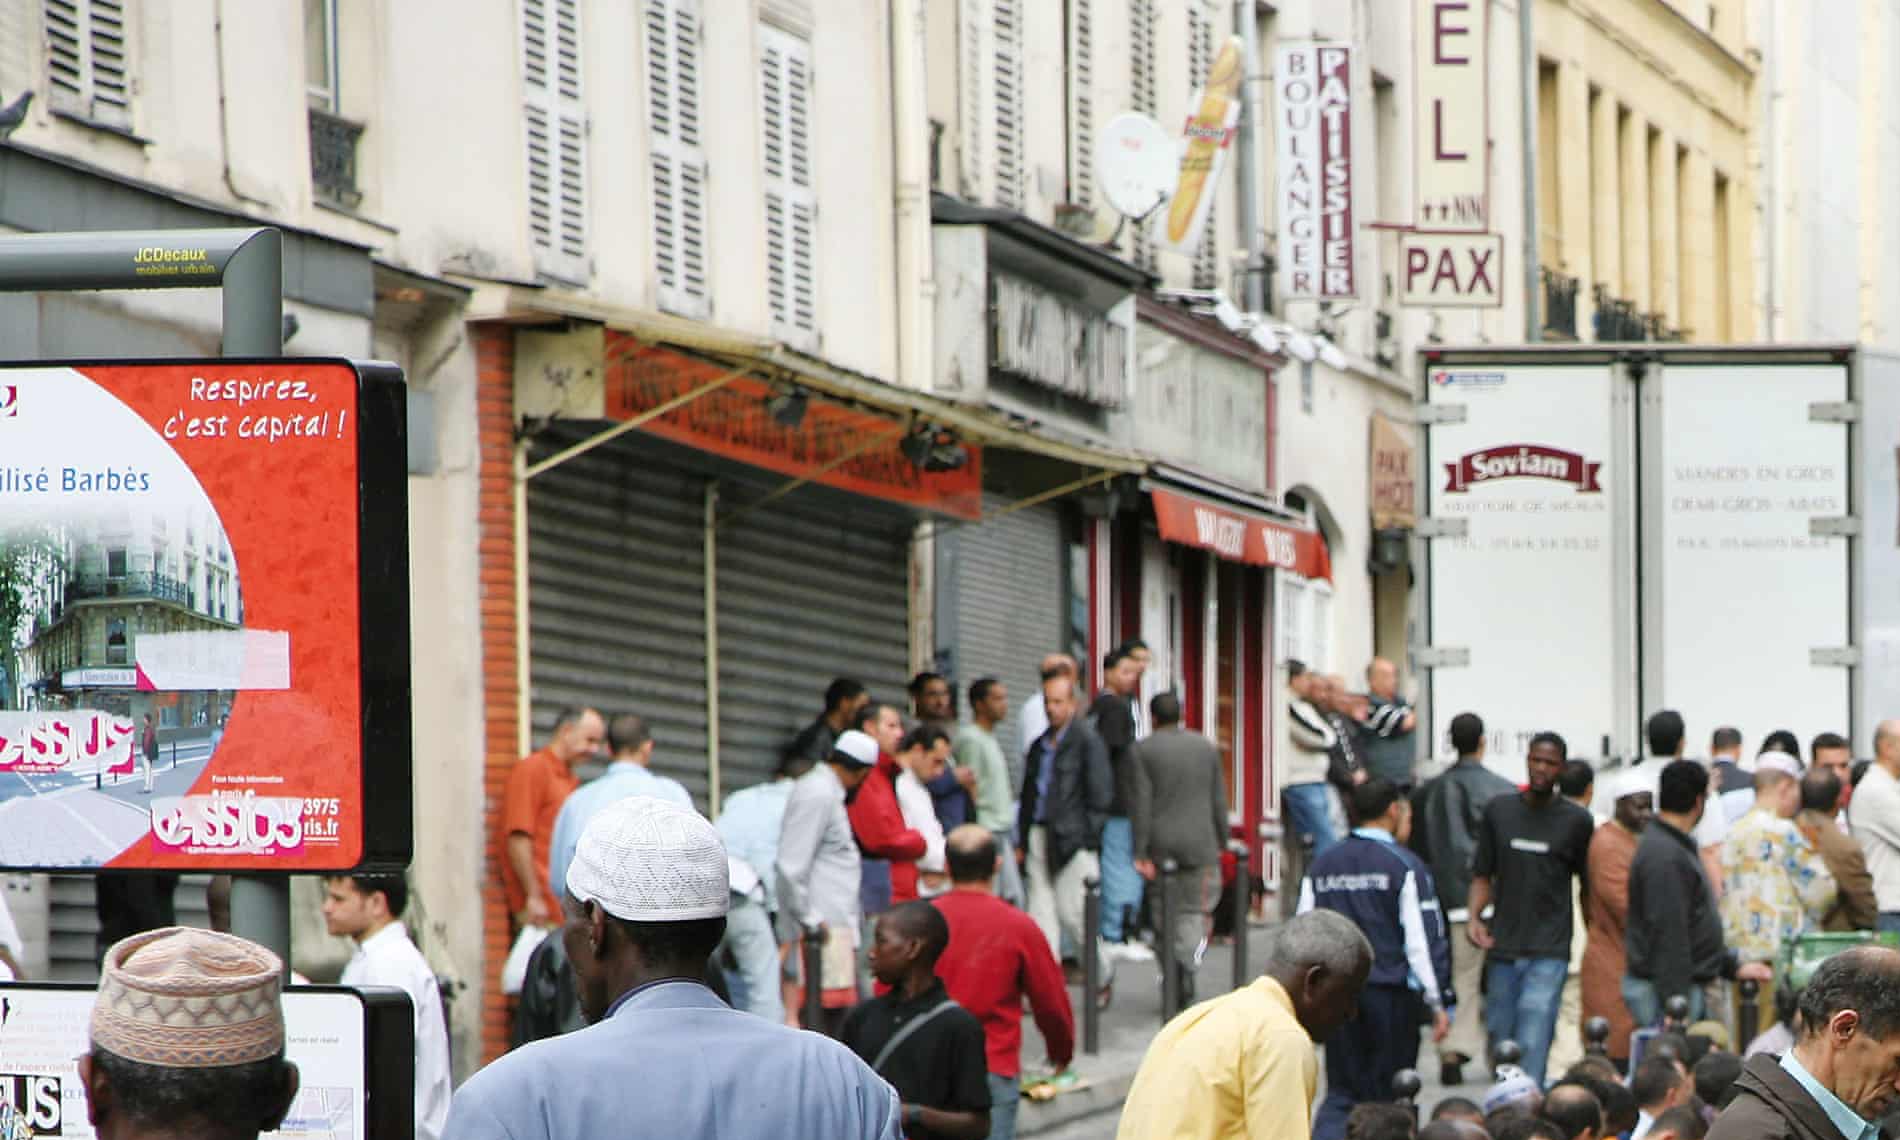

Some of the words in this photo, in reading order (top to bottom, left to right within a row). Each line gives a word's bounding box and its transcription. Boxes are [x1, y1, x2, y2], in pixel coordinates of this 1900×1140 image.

[1285, 53, 1312, 293] BOULANGER
[134, 247, 207, 263] JCDecaux
[1407, 248, 1493, 293] PAX
[191, 377, 317, 406] Respirez,
[164, 410, 229, 439] c'est
[238, 411, 328, 443] capital
[62, 465, 150, 492] Barbès
[1471, 448, 1569, 480] Soviam
[304, 798, 340, 815] 3975
